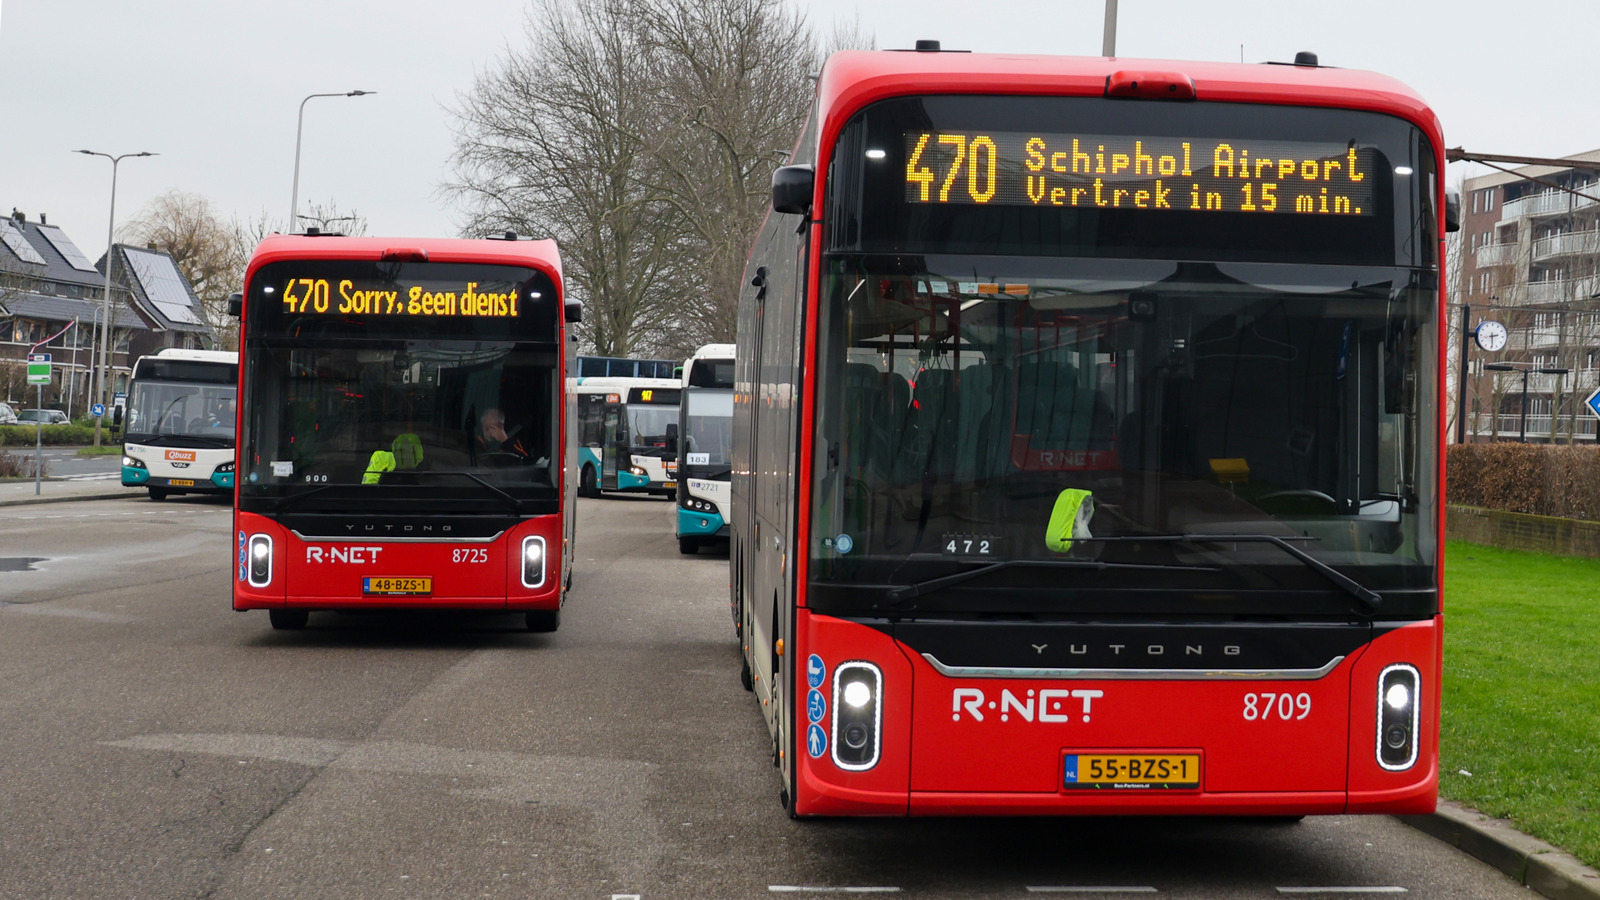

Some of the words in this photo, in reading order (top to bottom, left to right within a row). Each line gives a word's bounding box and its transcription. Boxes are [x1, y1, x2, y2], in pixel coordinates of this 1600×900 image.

[906, 133, 997, 203] 470
[1025, 137, 1192, 175] Schiphol
[1213, 143, 1364, 181] Airport
[1027, 175, 1171, 208] Vertrek
[1190, 183, 1222, 210] in
[1241, 182, 1277, 211] 15
[1296, 187, 1361, 214] min.
[283, 278, 330, 314] 470
[338, 279, 403, 315] Sorry,
[407, 286, 457, 316] geen
[460, 282, 518, 317] dienst
[169, 451, 192, 459] Qbuzz
[690, 456, 707, 464] 183
[305, 474, 328, 483] 900
[700, 483, 719, 492] 2721
[946, 540, 990, 554] 472
[452, 548, 488, 564] 8725
[375, 579, 426, 591] 48-BZS-1
[1031, 643, 1241, 656] YUTONG
[1242, 691, 1312, 721] 8709
[1089, 758, 1187, 779] 55-BZS-1
